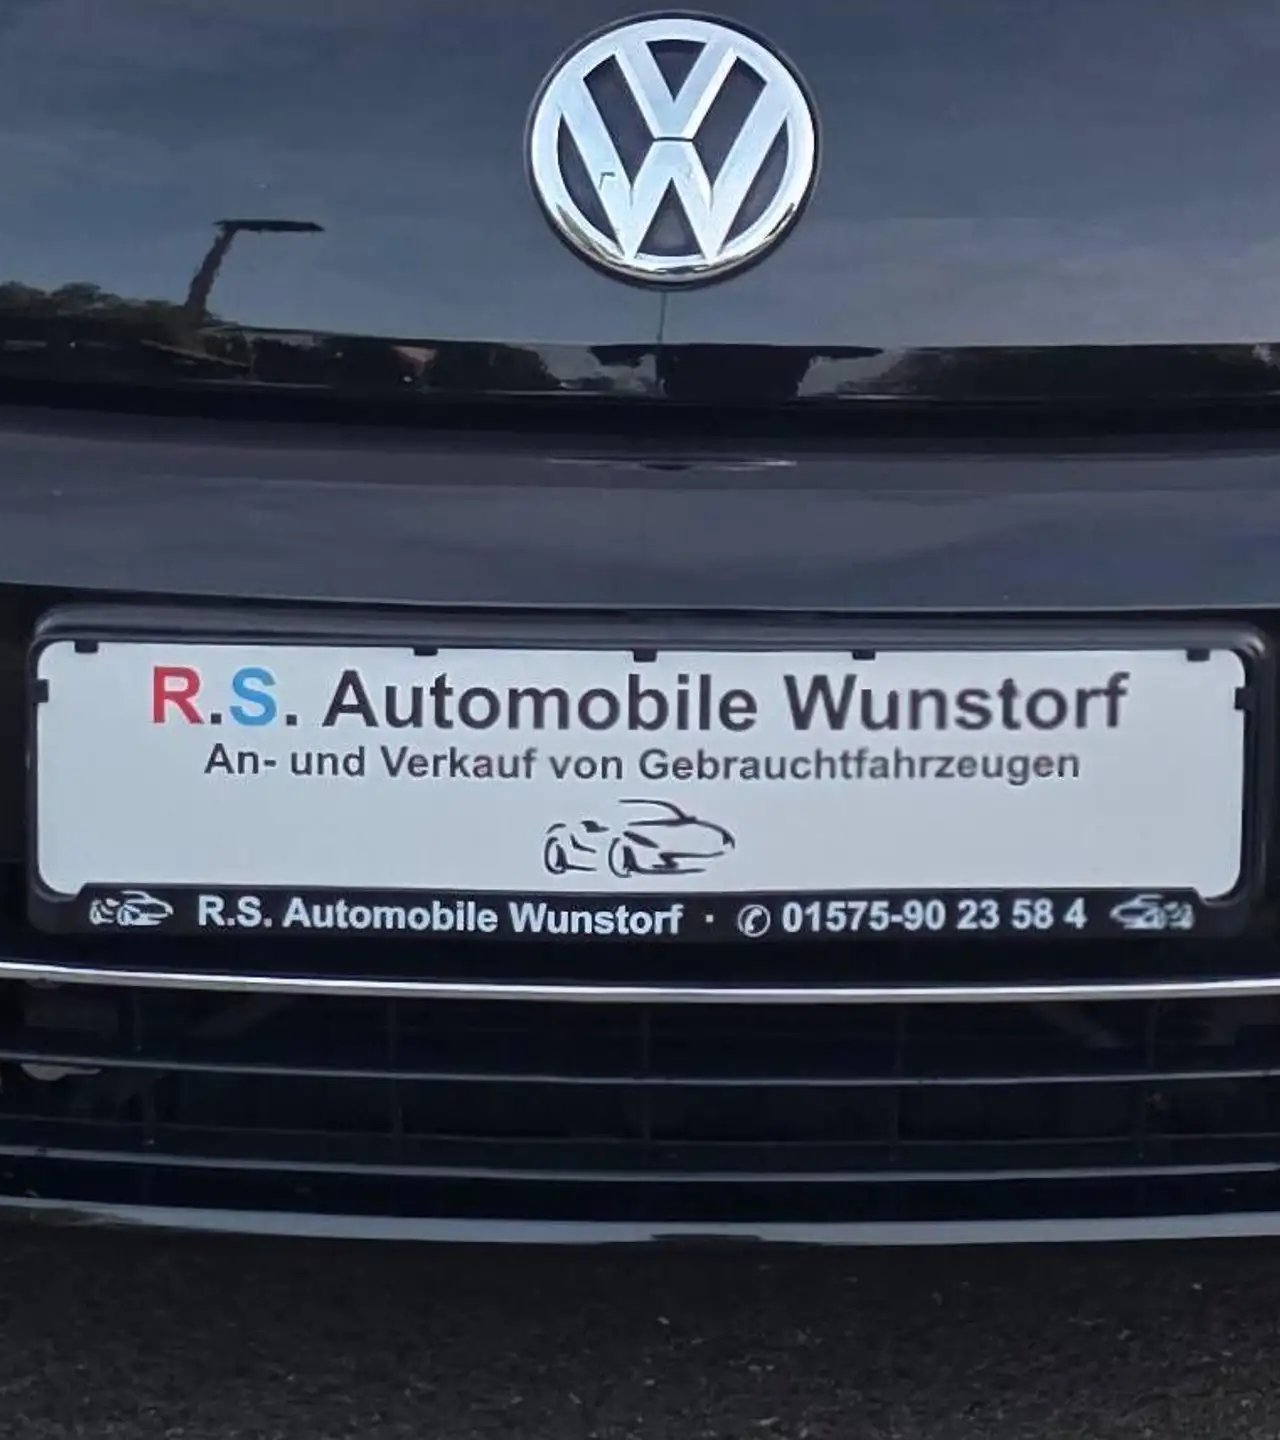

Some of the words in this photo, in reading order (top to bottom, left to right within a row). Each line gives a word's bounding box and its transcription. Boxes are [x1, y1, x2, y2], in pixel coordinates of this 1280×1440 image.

[151, 665, 299, 727] R.S.
[321, 668, 759, 732] Automobile
[783, 670, 1131, 732] Wunstorf
[203, 742, 278, 776] An-
[290, 745, 366, 777] und
[380, 745, 538, 780] Verkauf
[548, 756, 624, 781] von
[638, 747, 1081, 787] Gebrauchtfahrzeugen
[197, 894, 274, 929] R.S.
[282, 896, 499, 933] Automobile
[508, 900, 685, 935] Wunstorf
[781, 899, 947, 933] 01575-90
[956, 898, 1001, 931] 23
[1012, 898, 1055, 931] 58
[1064, 897, 1088, 930] 4
